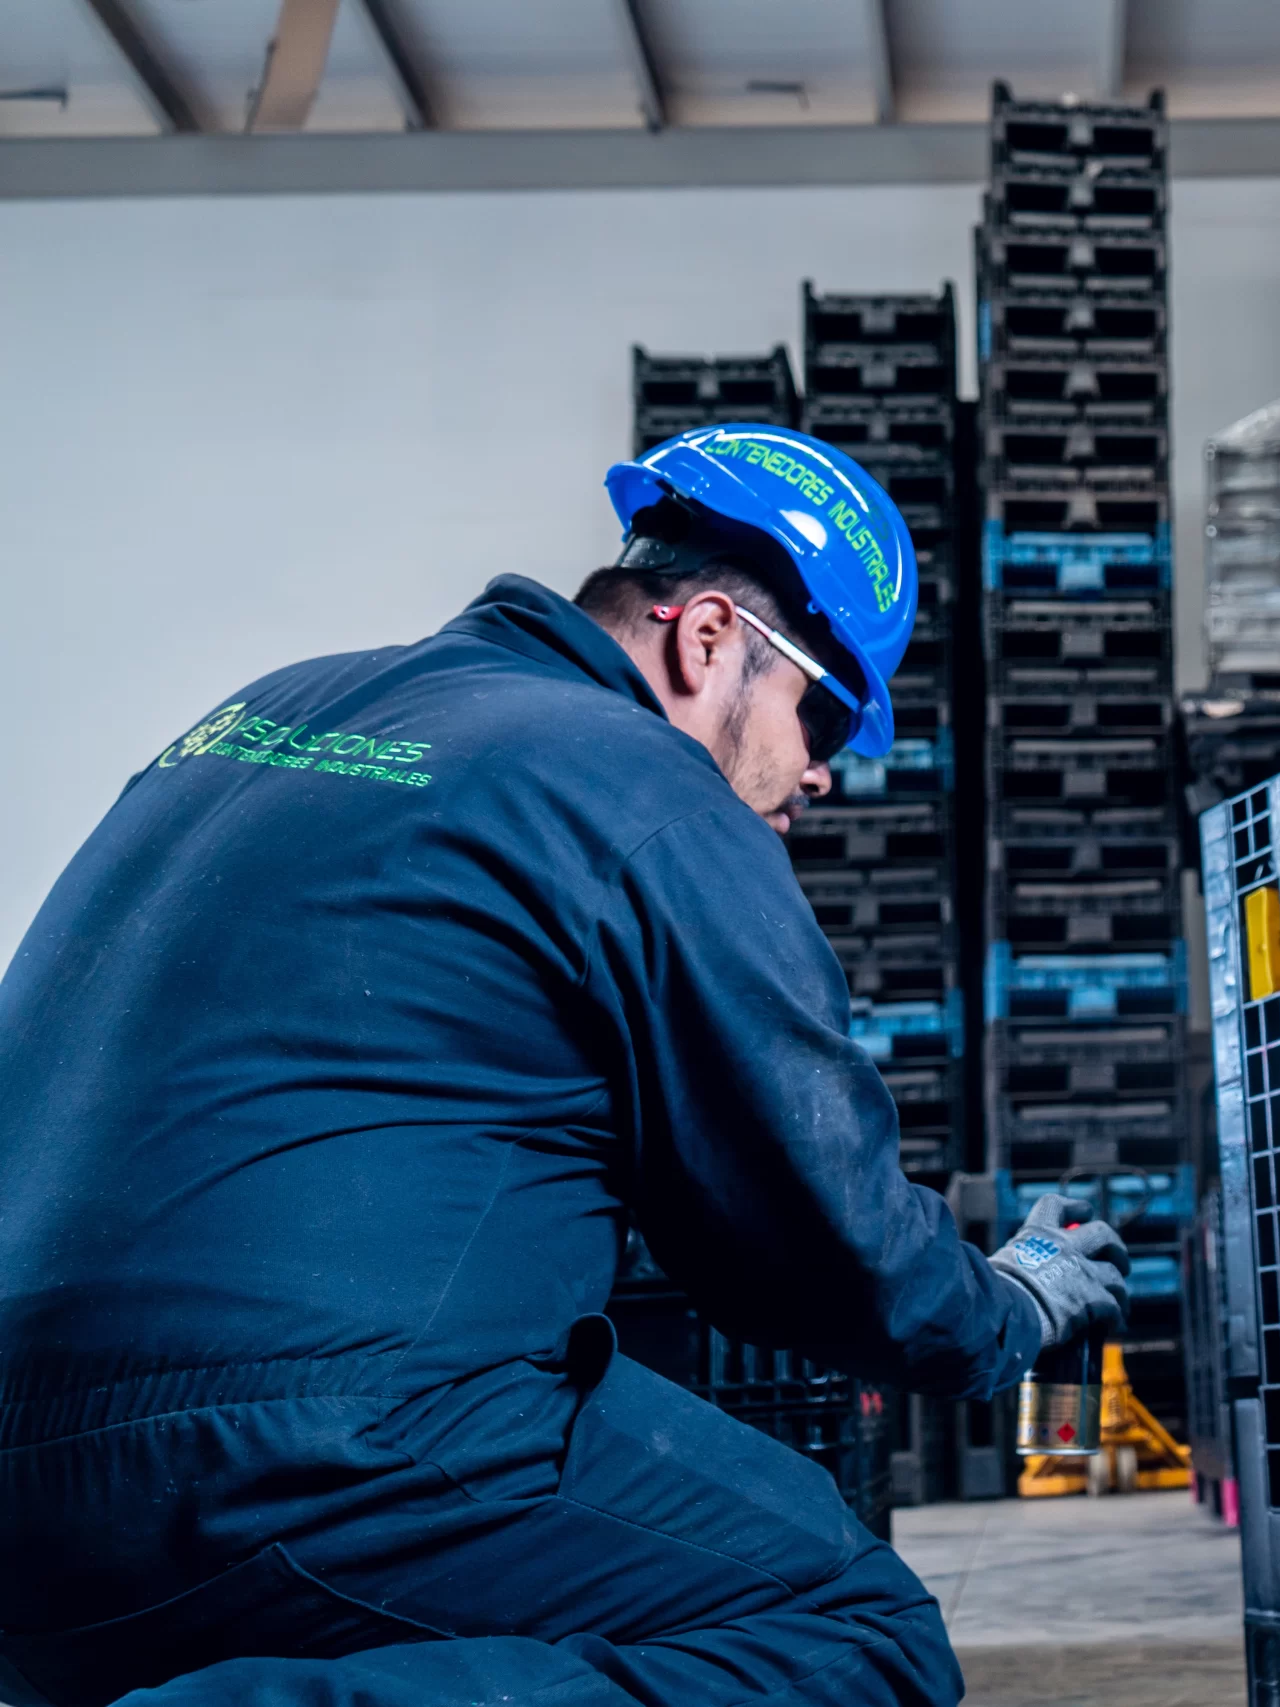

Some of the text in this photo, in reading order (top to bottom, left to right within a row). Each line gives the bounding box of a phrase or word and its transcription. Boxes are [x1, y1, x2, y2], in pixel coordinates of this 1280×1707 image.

[705, 438, 835, 506] CONTENEDORES
[827, 499, 896, 613] INDUSTRIALES
[314, 759, 432, 787] INDUSTRIALES
